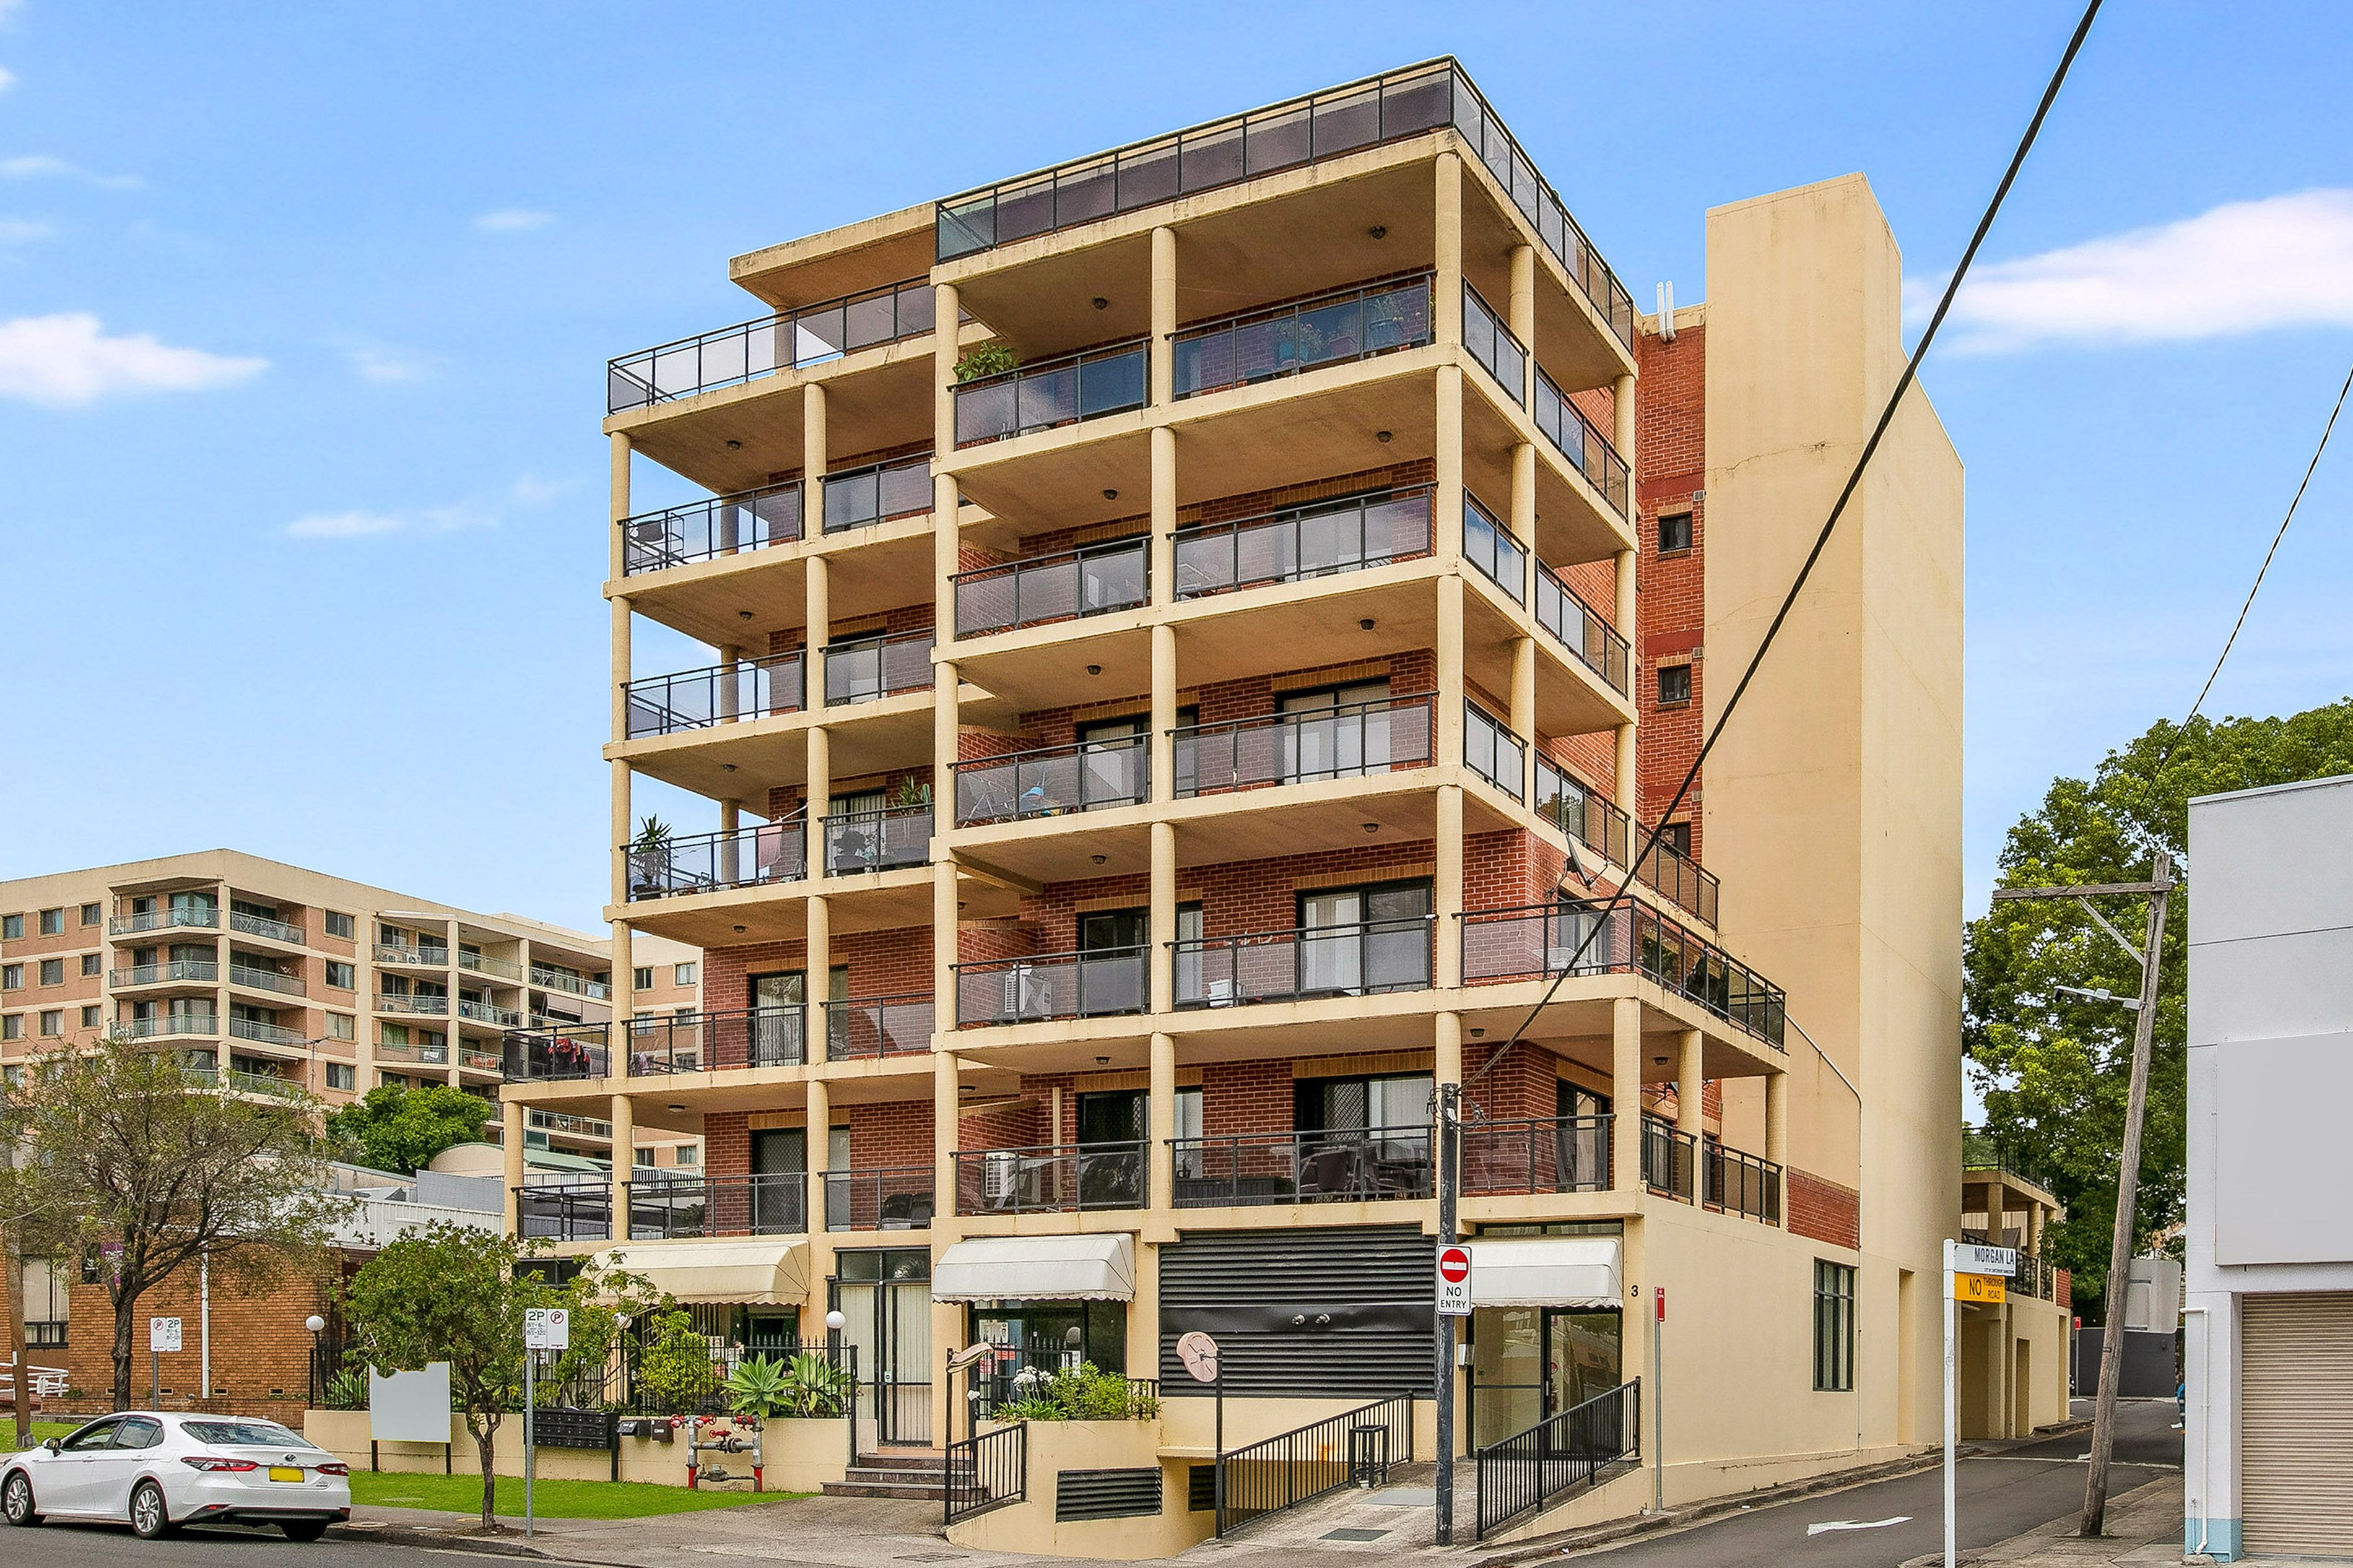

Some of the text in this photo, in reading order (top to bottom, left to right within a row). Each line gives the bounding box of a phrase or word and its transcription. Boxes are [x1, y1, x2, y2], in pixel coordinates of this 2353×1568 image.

[1975, 1247, 2014, 1265] MORGAN LA
[1446, 1286, 1462, 1297] NO
[1631, 1284, 1638, 1297] 3
[1969, 1278, 1981, 1296] NO
[1440, 1299, 1467, 1309] ENTRY
[528, 1311, 545, 1321] 2P
[168, 1319, 180, 1328] 2P
